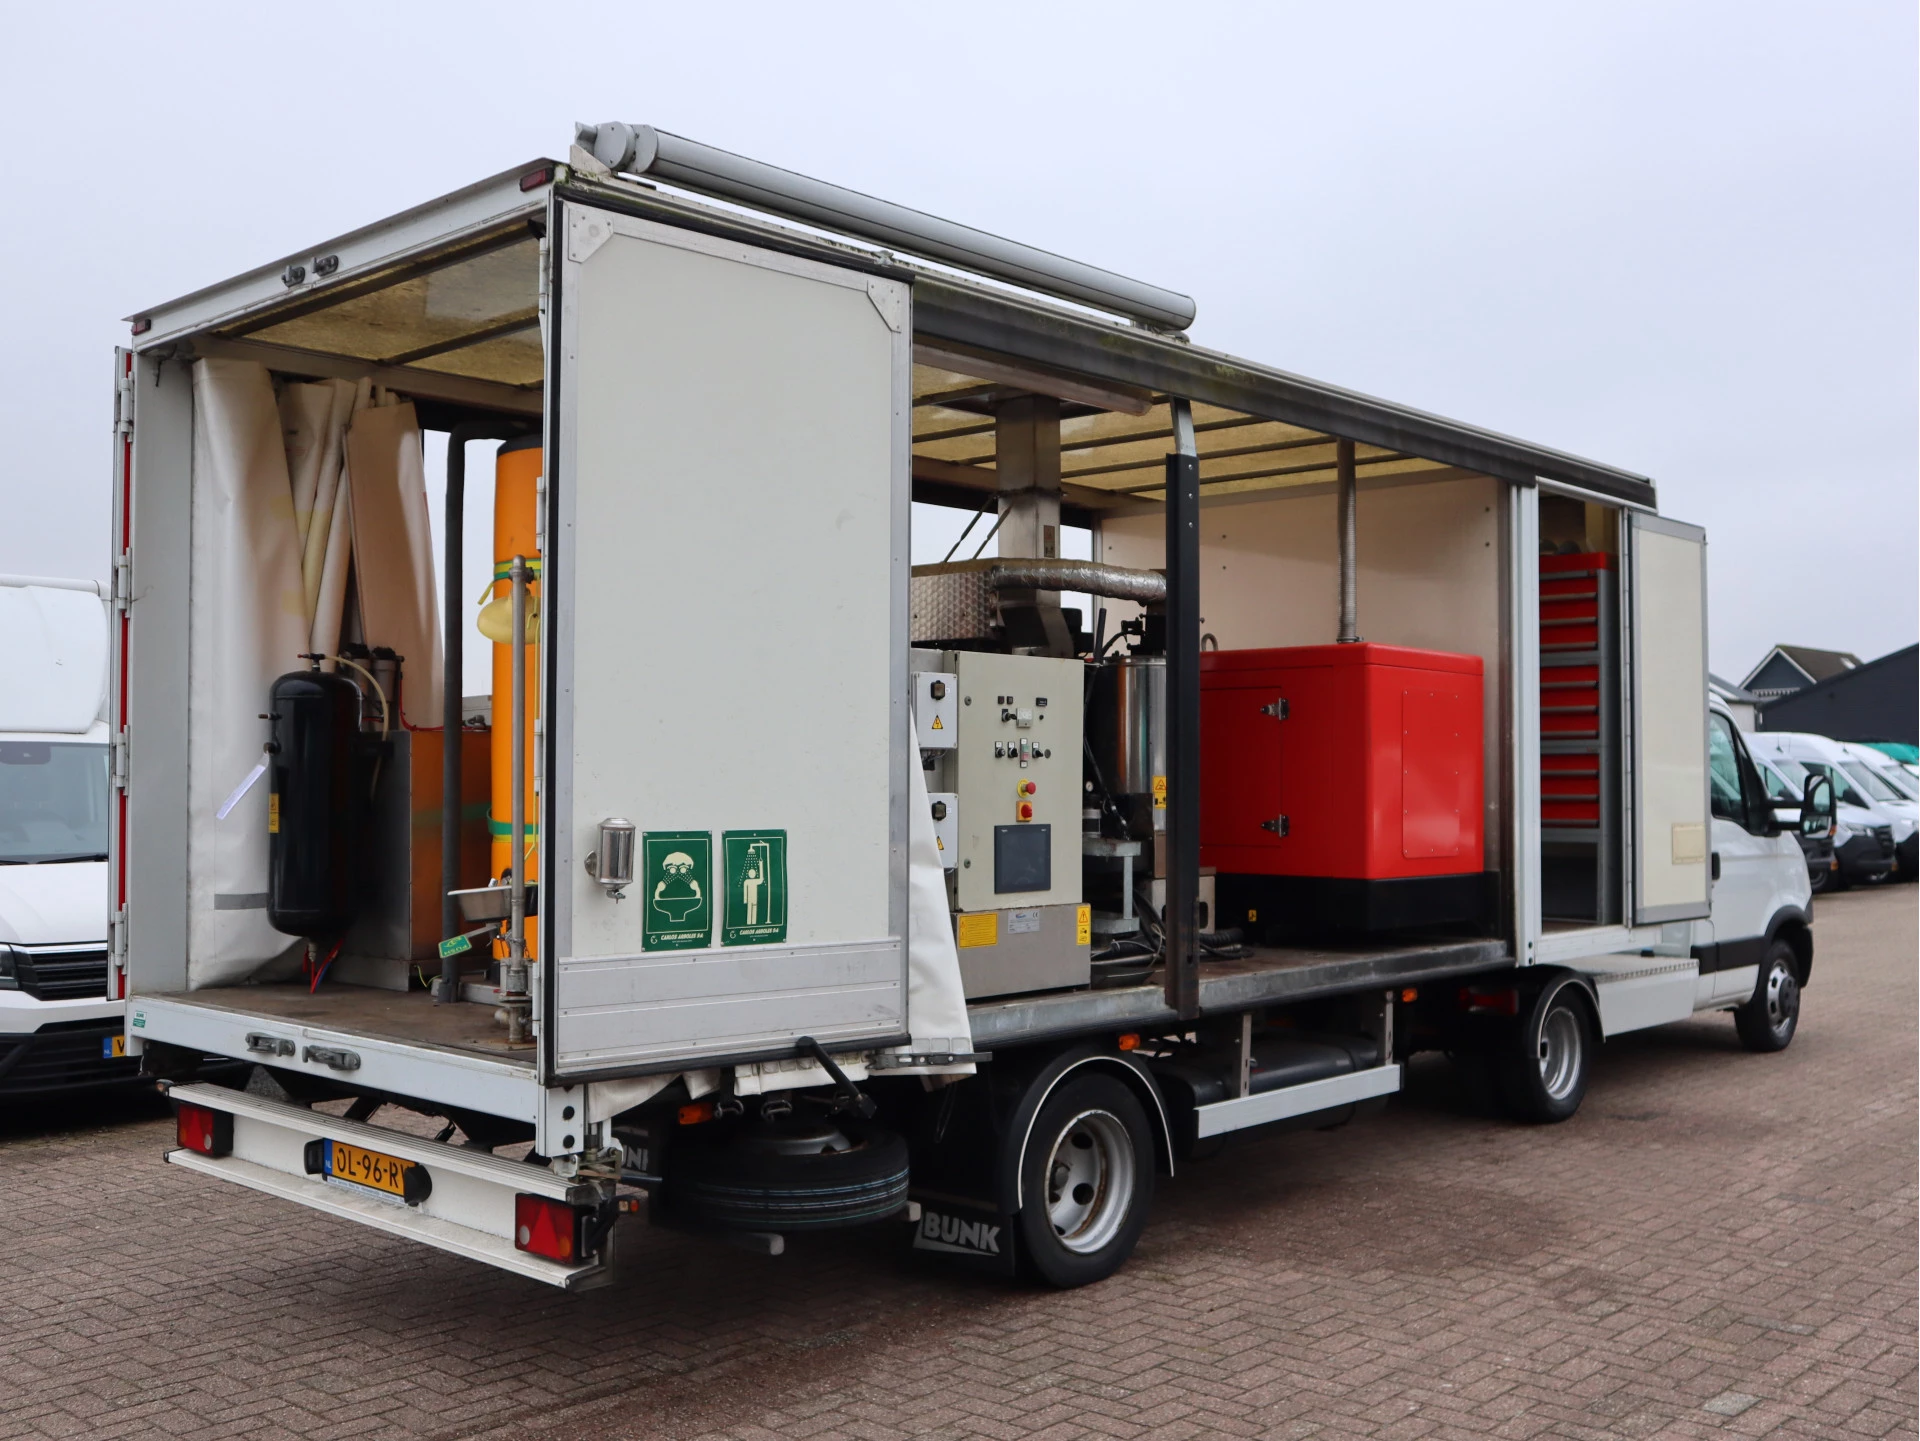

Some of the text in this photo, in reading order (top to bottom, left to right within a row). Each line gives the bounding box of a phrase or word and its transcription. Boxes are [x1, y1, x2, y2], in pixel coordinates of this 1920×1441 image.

[660, 933, 678, 941] CARLOS
[325, 1159, 332, 1169] NL
[923, 1210, 1001, 1254] BUNK
